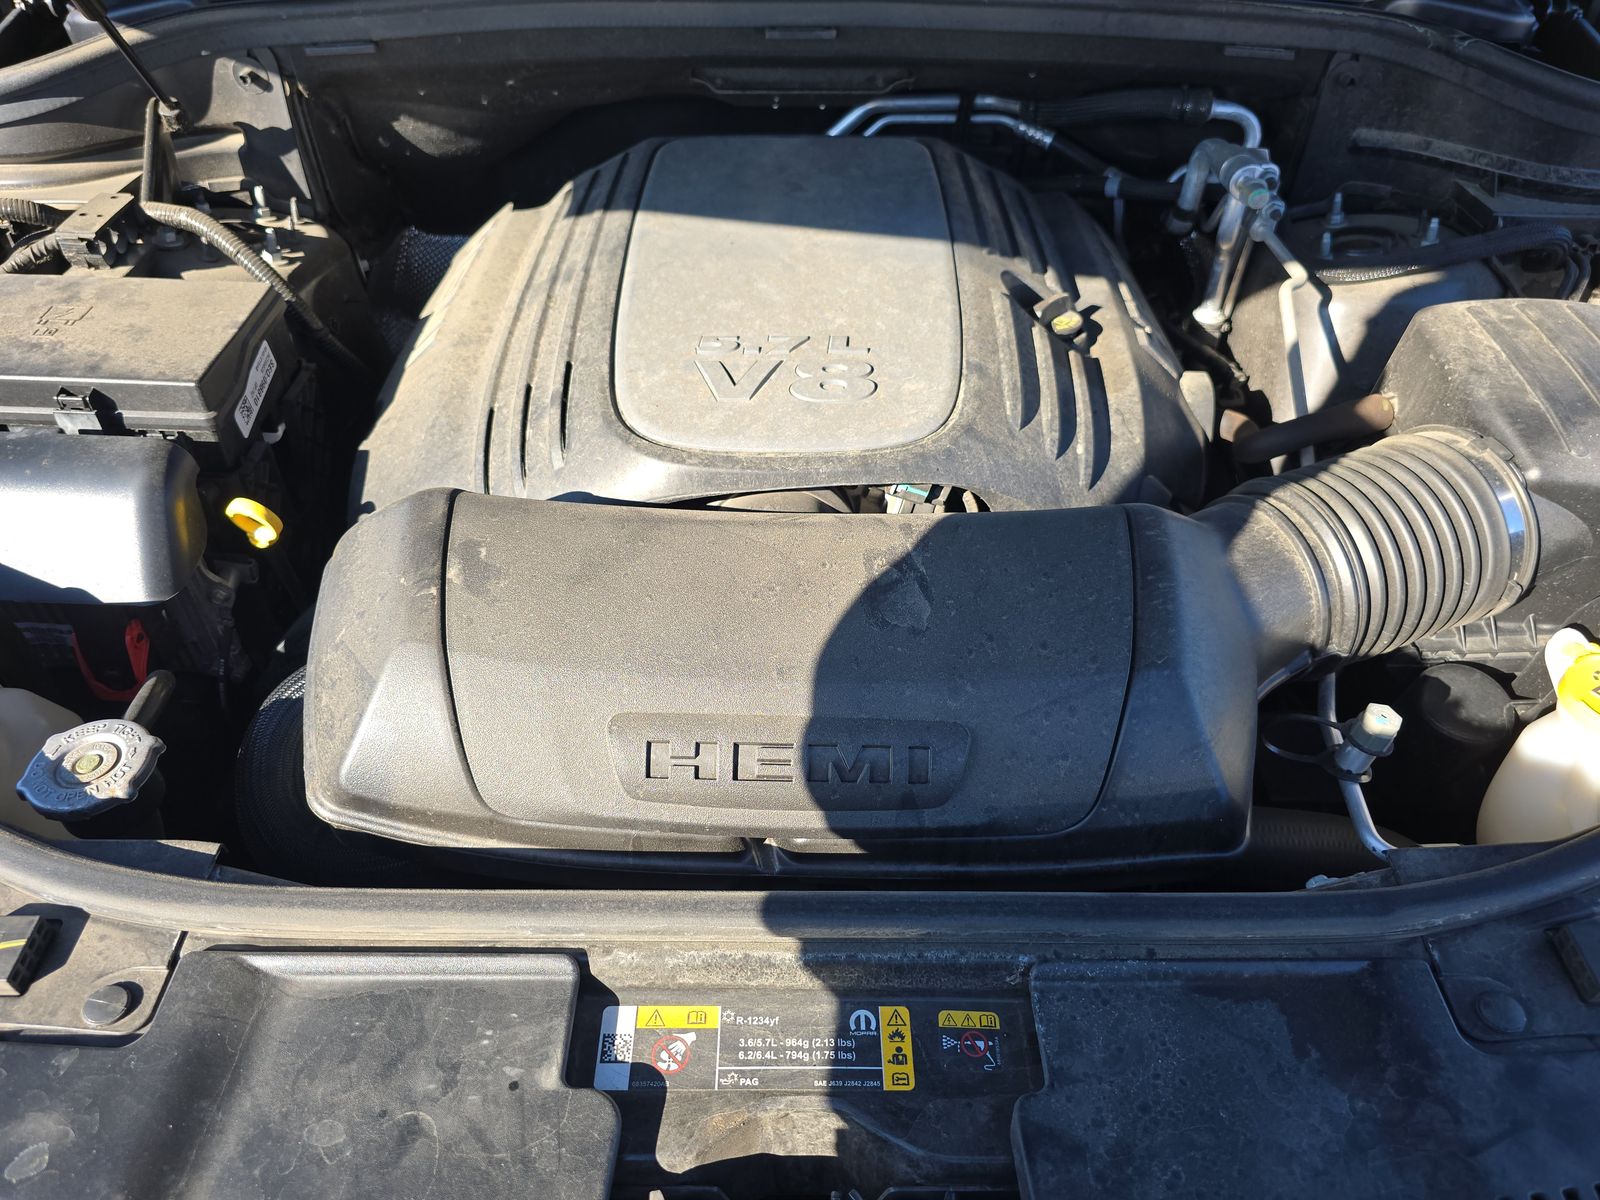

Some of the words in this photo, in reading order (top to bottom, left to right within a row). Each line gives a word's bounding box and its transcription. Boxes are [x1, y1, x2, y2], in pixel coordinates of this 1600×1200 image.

[693, 359, 878, 403] V8
[645, 739, 932, 786] HEMI
[736, 1016, 780, 1027] R-1234yf
[738, 1038, 778, 1047] 3.6/5.7L
[785, 1038, 809, 1049] 964g
[812, 1038, 835, 1048] (2.13
[837, 1038, 856, 1048] lbs)
[738, 1051, 778, 1060] 6.2/6.4L
[785, 1051, 809, 1061] 794g
[812, 1051, 836, 1060] (1.75
[837, 1051, 856, 1061] lbs)
[739, 1077, 759, 1086] PAG
